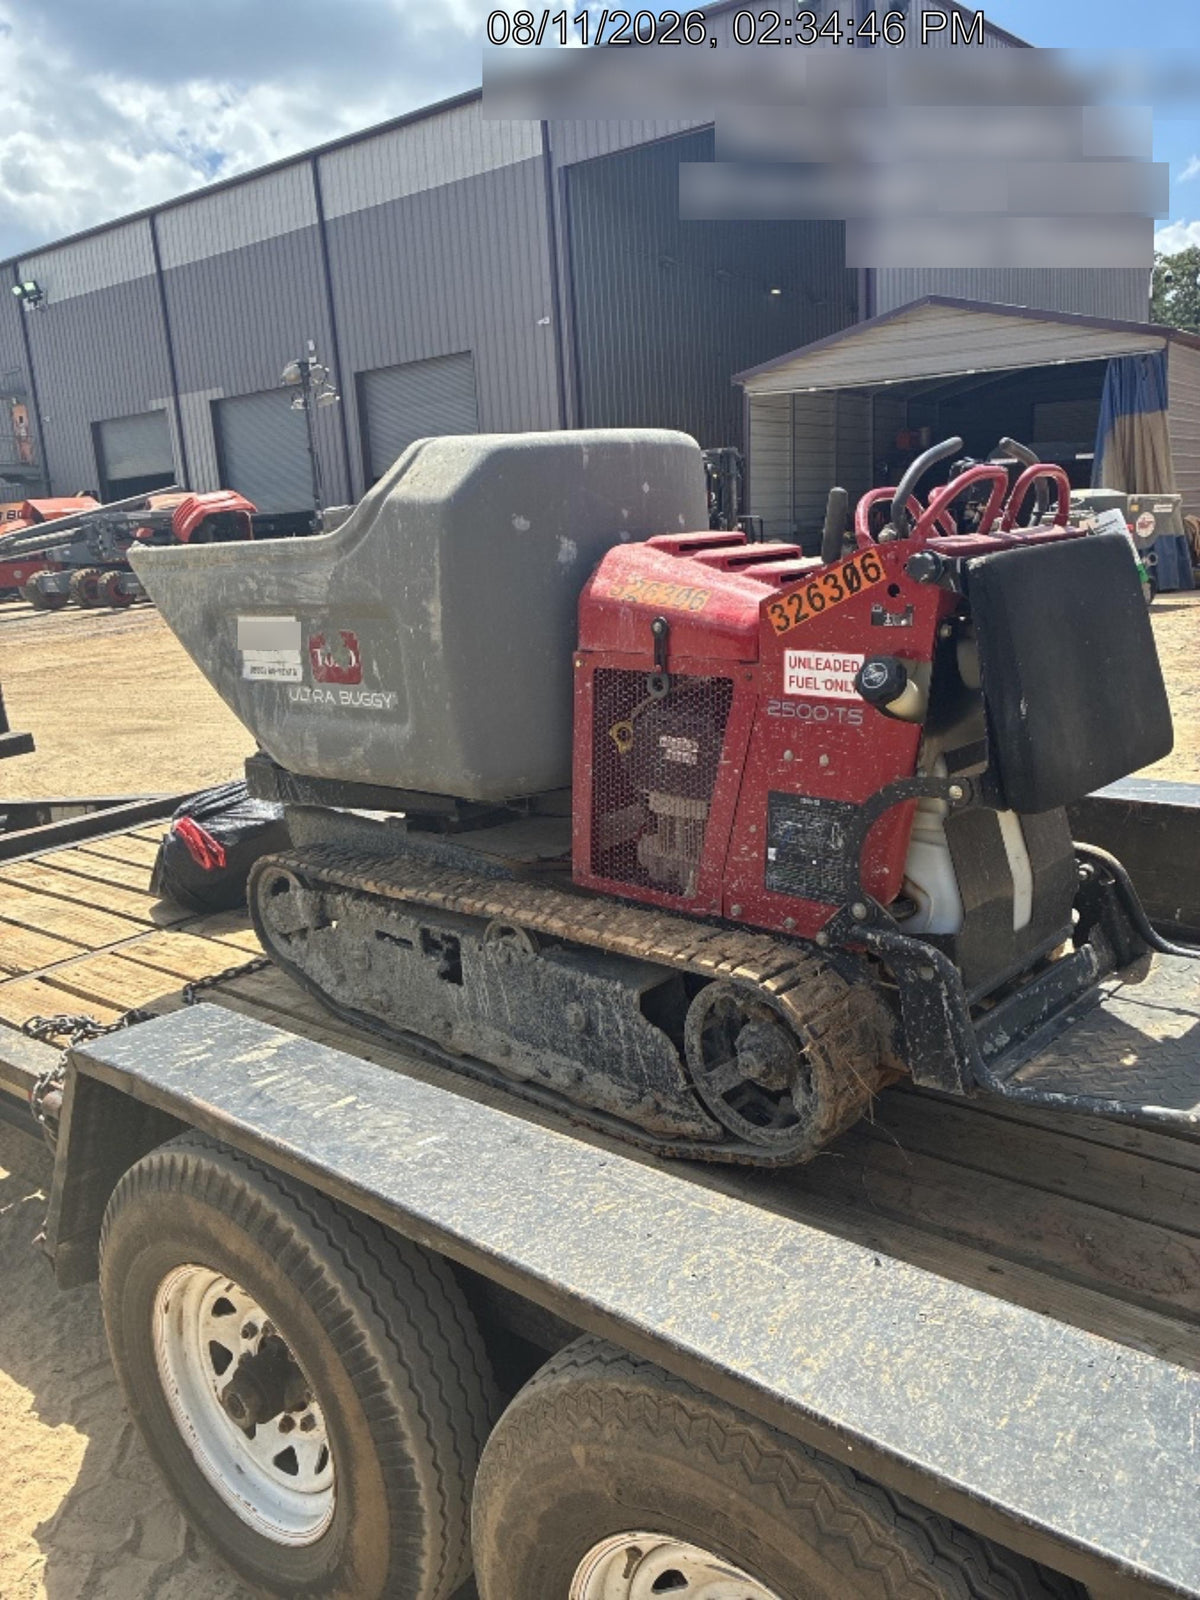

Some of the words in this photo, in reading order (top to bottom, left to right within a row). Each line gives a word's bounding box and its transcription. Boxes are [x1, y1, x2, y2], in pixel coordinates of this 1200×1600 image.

[770, 552, 881, 632] 326306
[788, 655, 860, 674] UNLEADED
[788, 675, 820, 690] FUEL
[289, 687, 336, 705] ULTRA
[340, 690, 392, 709] BUGGY
